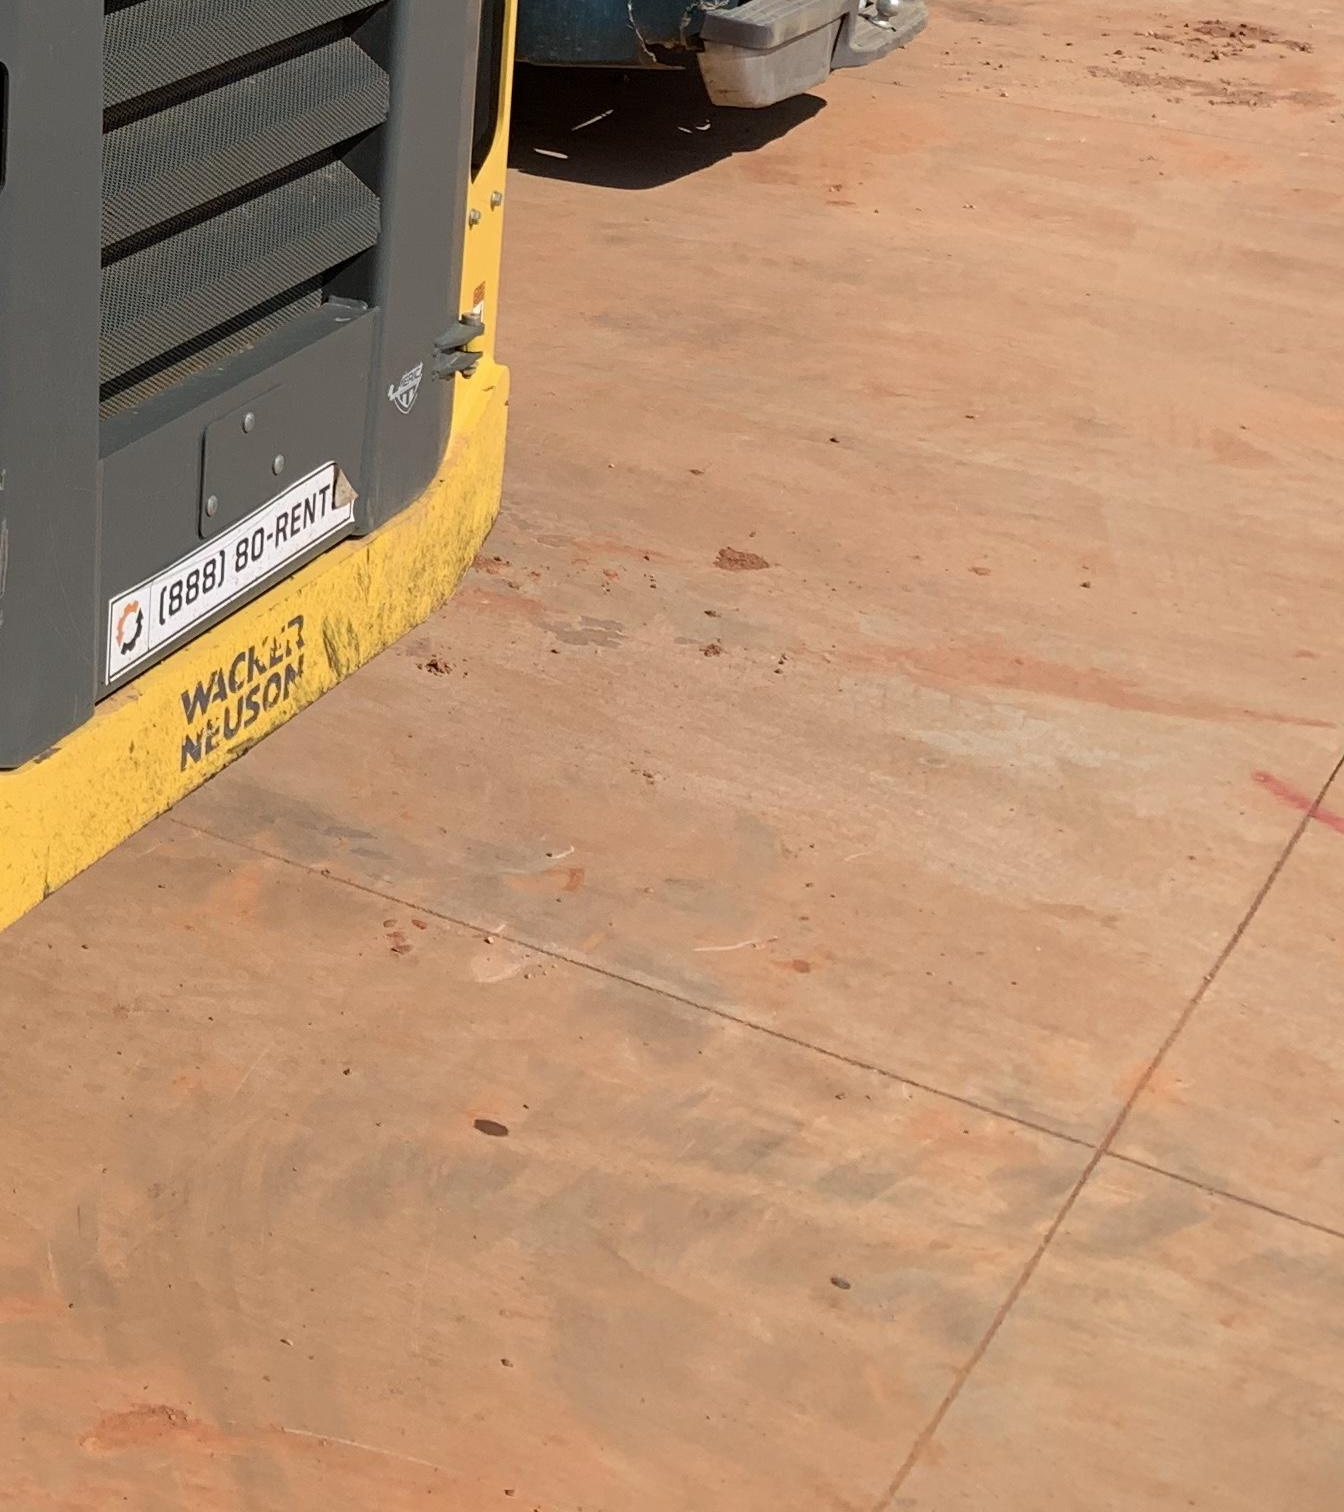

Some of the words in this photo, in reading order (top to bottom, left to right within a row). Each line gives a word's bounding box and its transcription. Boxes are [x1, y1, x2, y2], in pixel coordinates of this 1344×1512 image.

[158, 549, 226, 626] (888)
[234, 484, 339, 573] 80-RENT
[179, 653, 305, 773] NEUSON
[180, 614, 305, 726] WACKER
